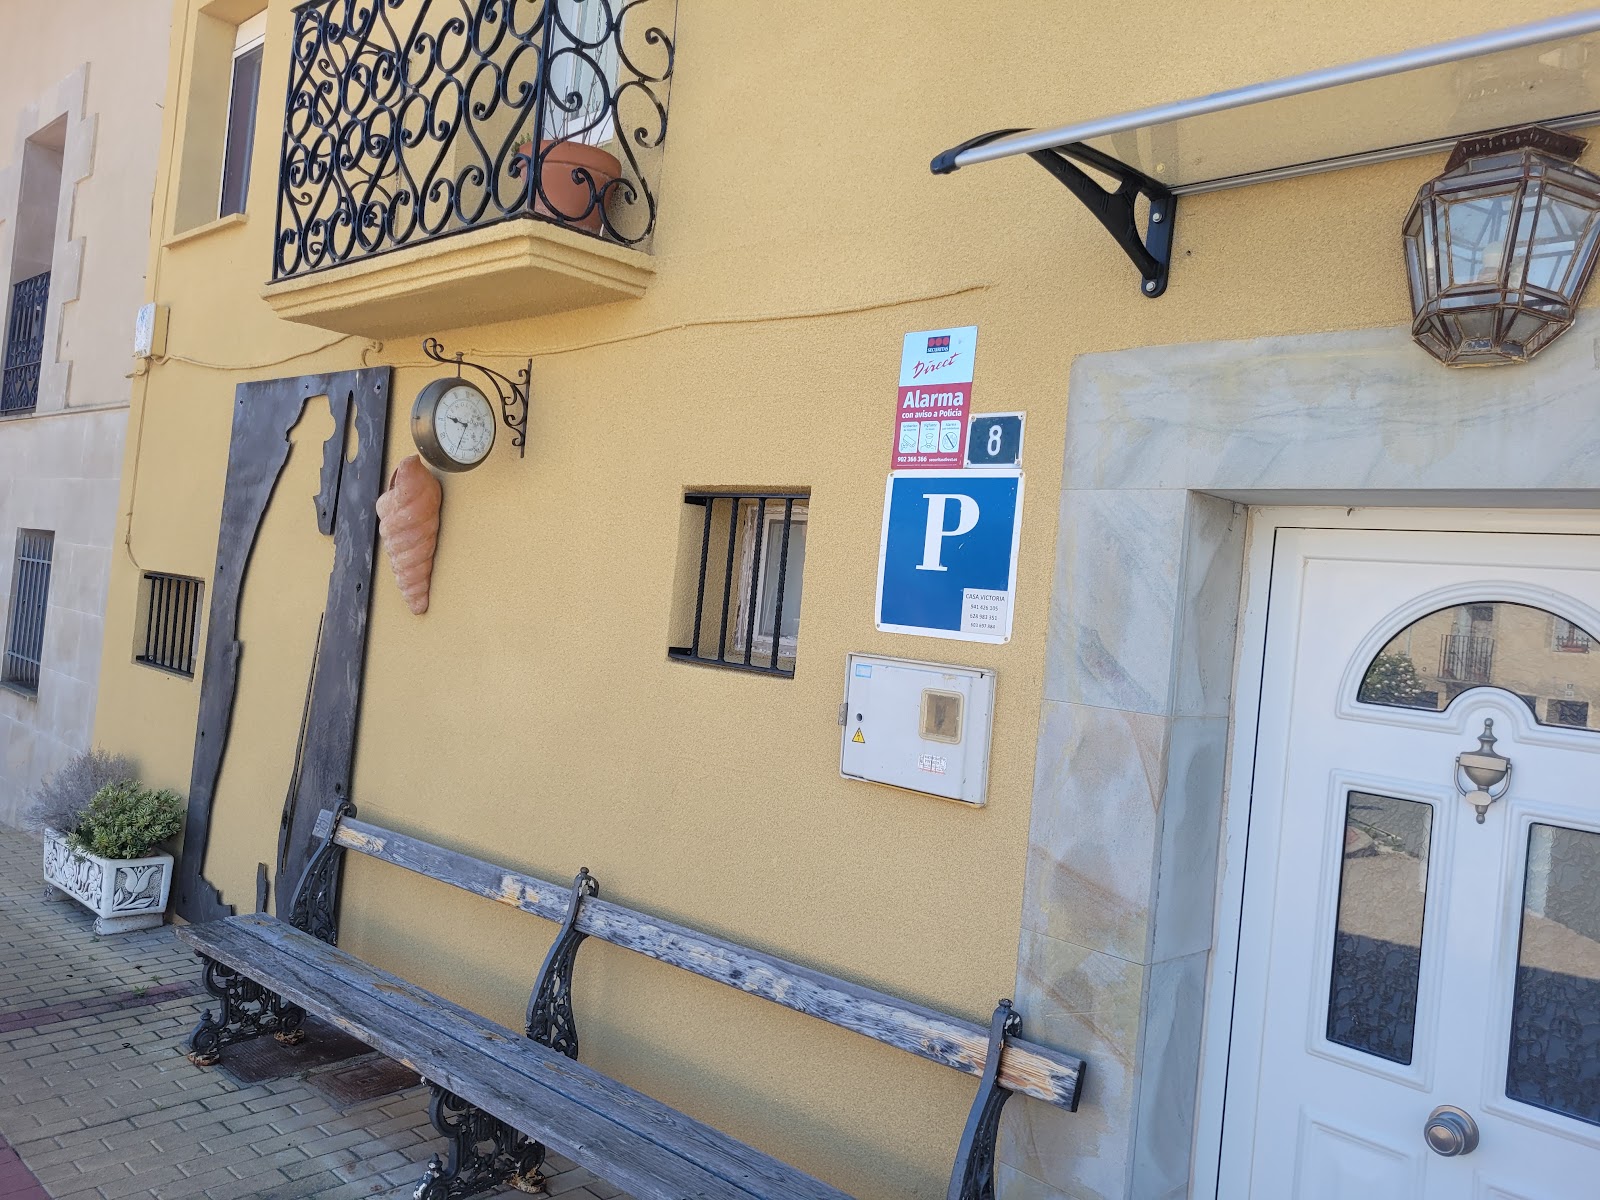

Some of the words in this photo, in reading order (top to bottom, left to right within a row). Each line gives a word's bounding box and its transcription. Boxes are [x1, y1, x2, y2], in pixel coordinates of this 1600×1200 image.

[912, 352, 962, 379] Direct
[902, 389, 964, 408] Alarma
[914, 410, 932, 418] aviso
[939, 408, 962, 417] Policía
[987, 425, 1003, 456] 8
[915, 493, 980, 572] P
